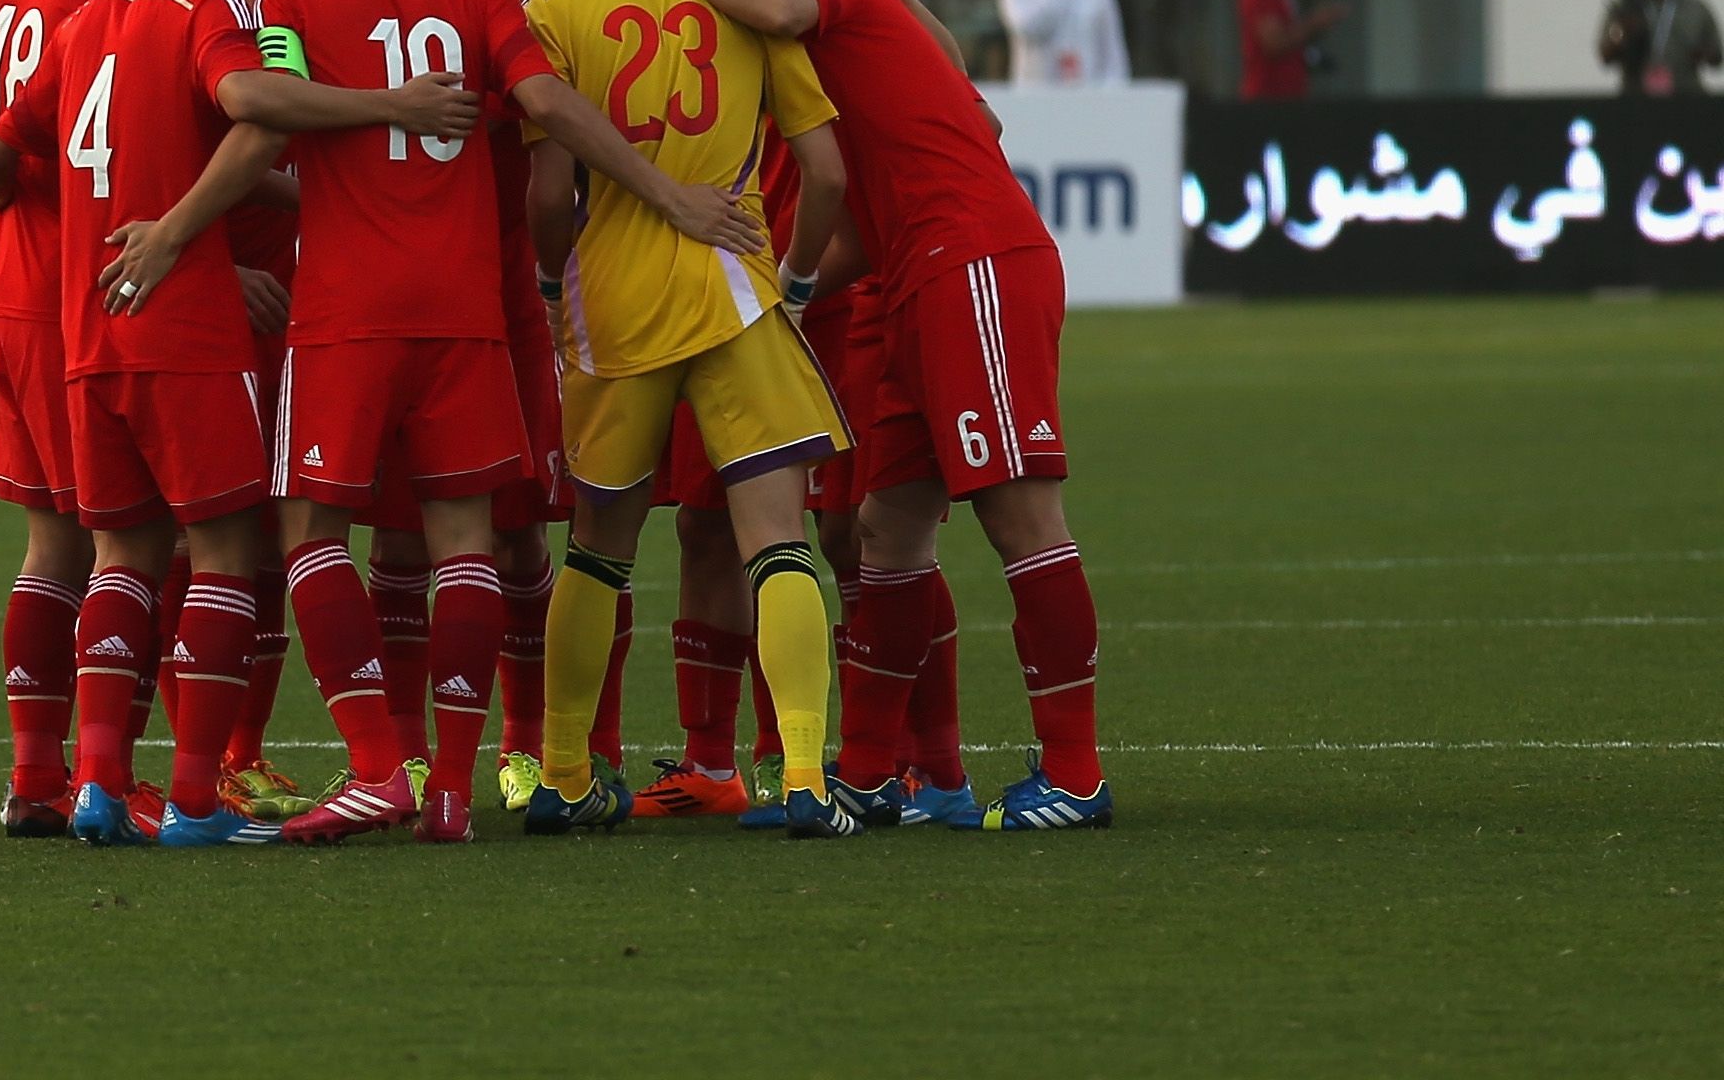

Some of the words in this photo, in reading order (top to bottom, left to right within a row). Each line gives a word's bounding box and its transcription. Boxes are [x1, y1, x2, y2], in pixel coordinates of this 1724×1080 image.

[601, 0, 720, 144] 23
[67, 53, 117, 199] 4
[1492, 117, 1606, 261] في
[958, 410, 990, 468] 6
[85, 647, 134, 658] adidas
[435, 686, 478, 698] adidas
